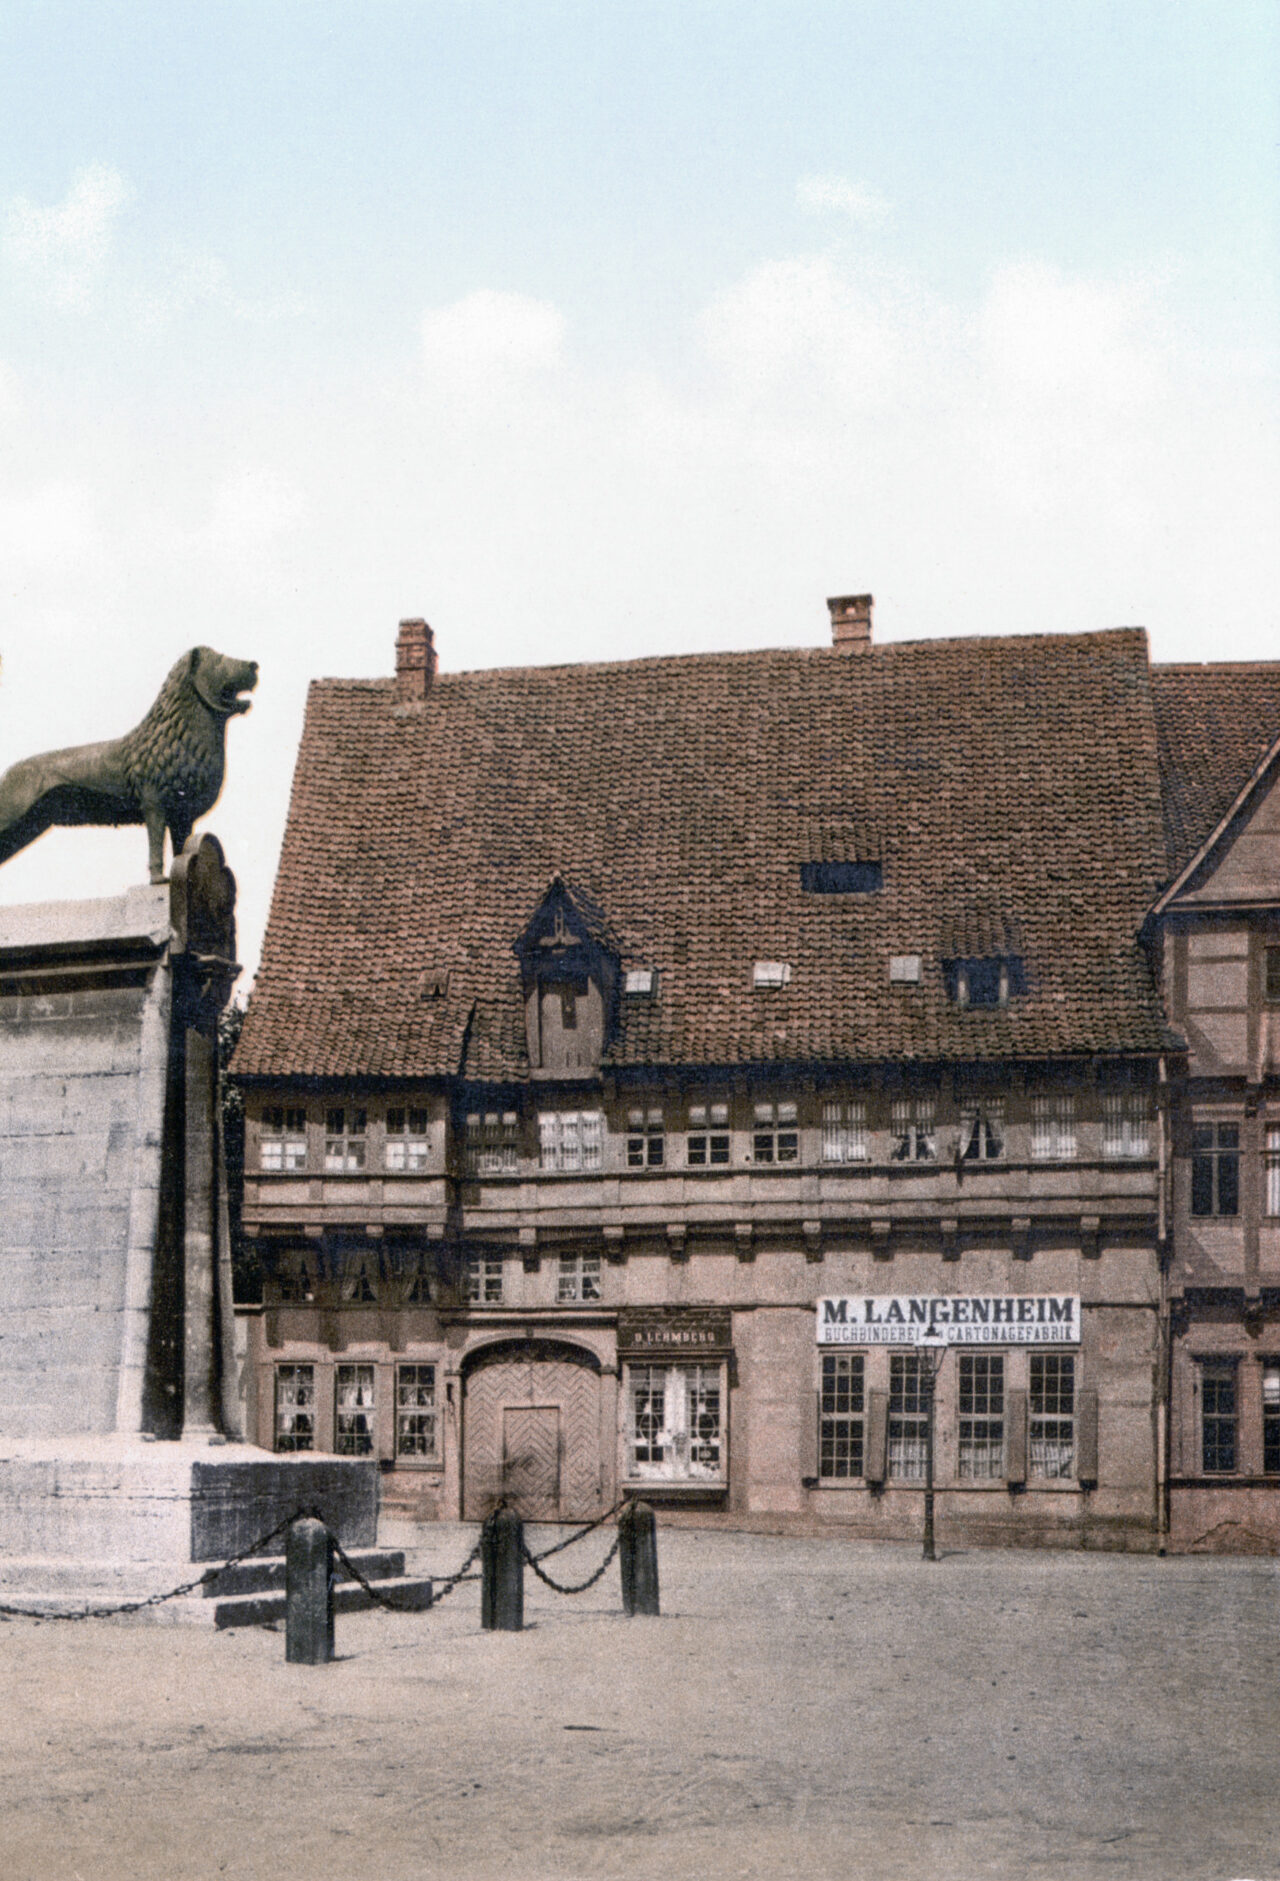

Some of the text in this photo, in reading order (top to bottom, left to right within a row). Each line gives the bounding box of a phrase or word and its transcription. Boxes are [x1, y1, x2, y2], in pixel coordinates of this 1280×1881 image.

[823, 1298, 1074, 1324] M. LANGENHEIM
[825, 1327, 920, 1341] BUCHBINDEREI
[947, 1326, 1072, 1341] CARTONAGEFABRIK
